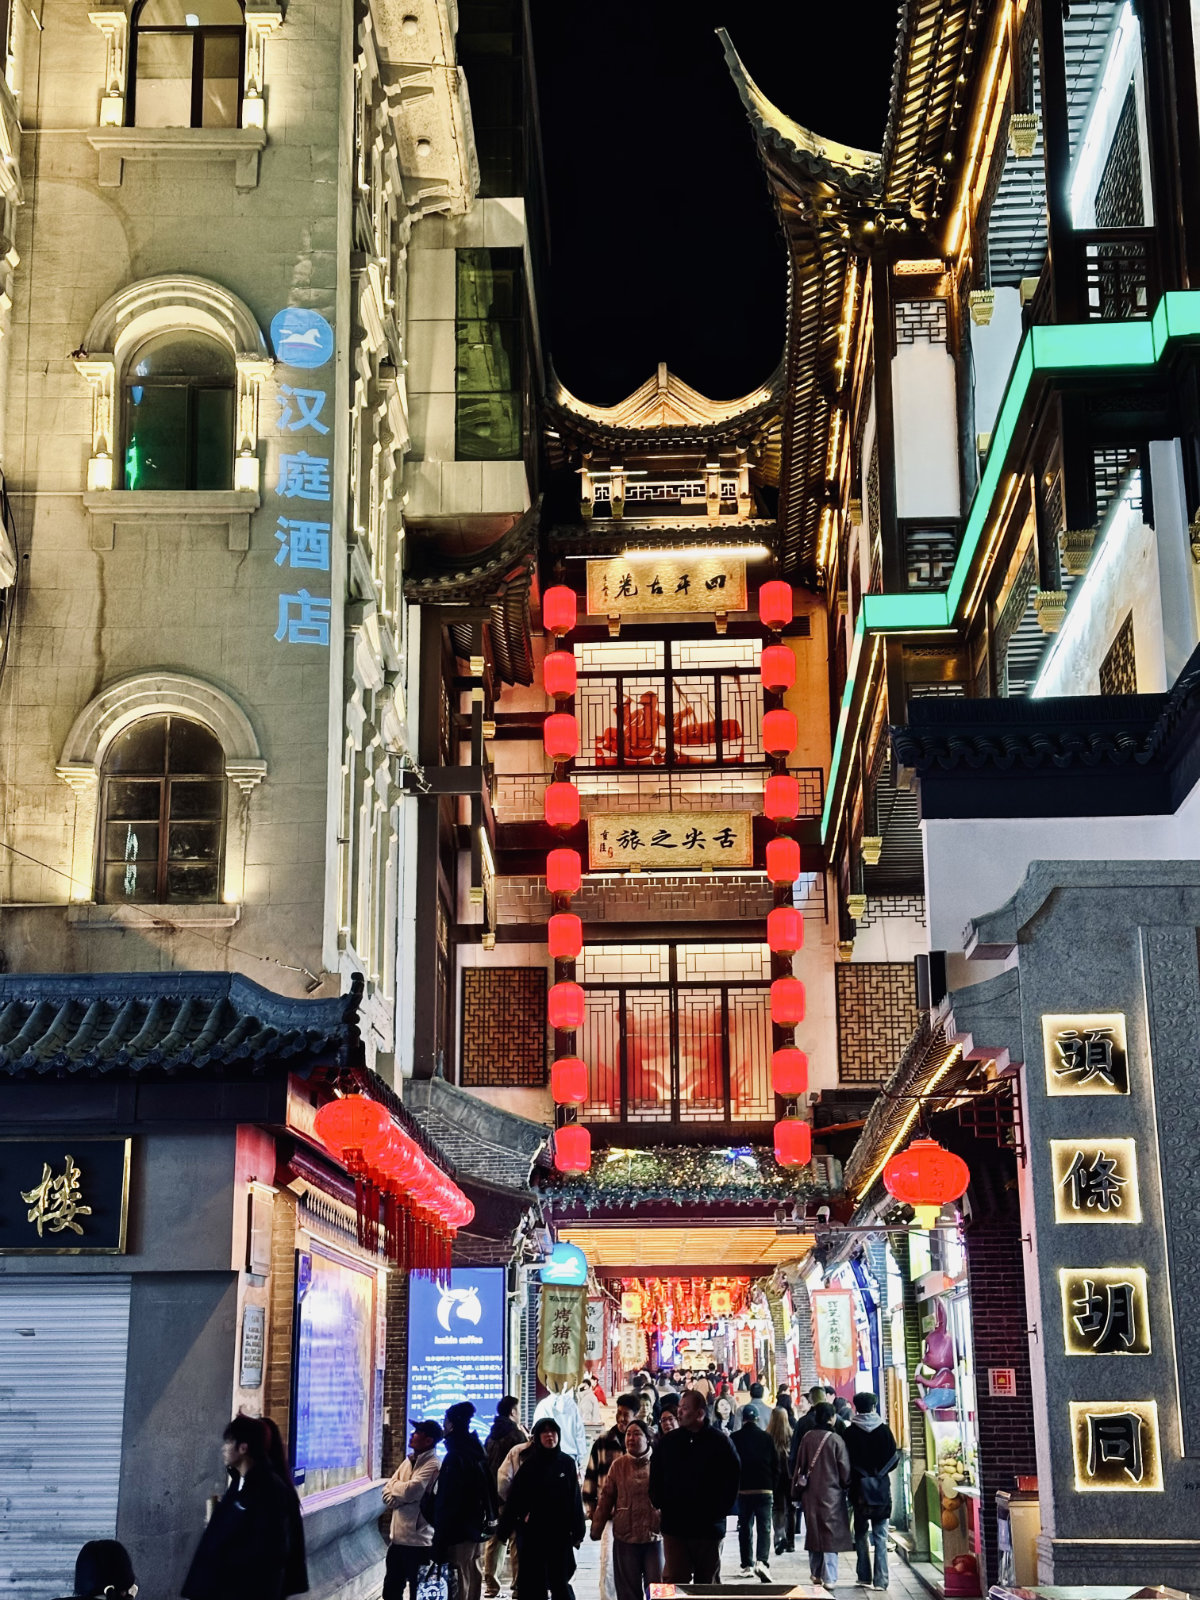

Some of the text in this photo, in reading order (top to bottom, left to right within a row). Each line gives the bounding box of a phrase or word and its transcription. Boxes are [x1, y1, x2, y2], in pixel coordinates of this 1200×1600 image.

[274, 383, 331, 646] 汉庭酒店
[616, 827, 738, 850] 舌尖之旅
[551, 1307, 573, 1357] 烤猪蹄
[1053, 1026, 1144, 1484] 頭條胡同
